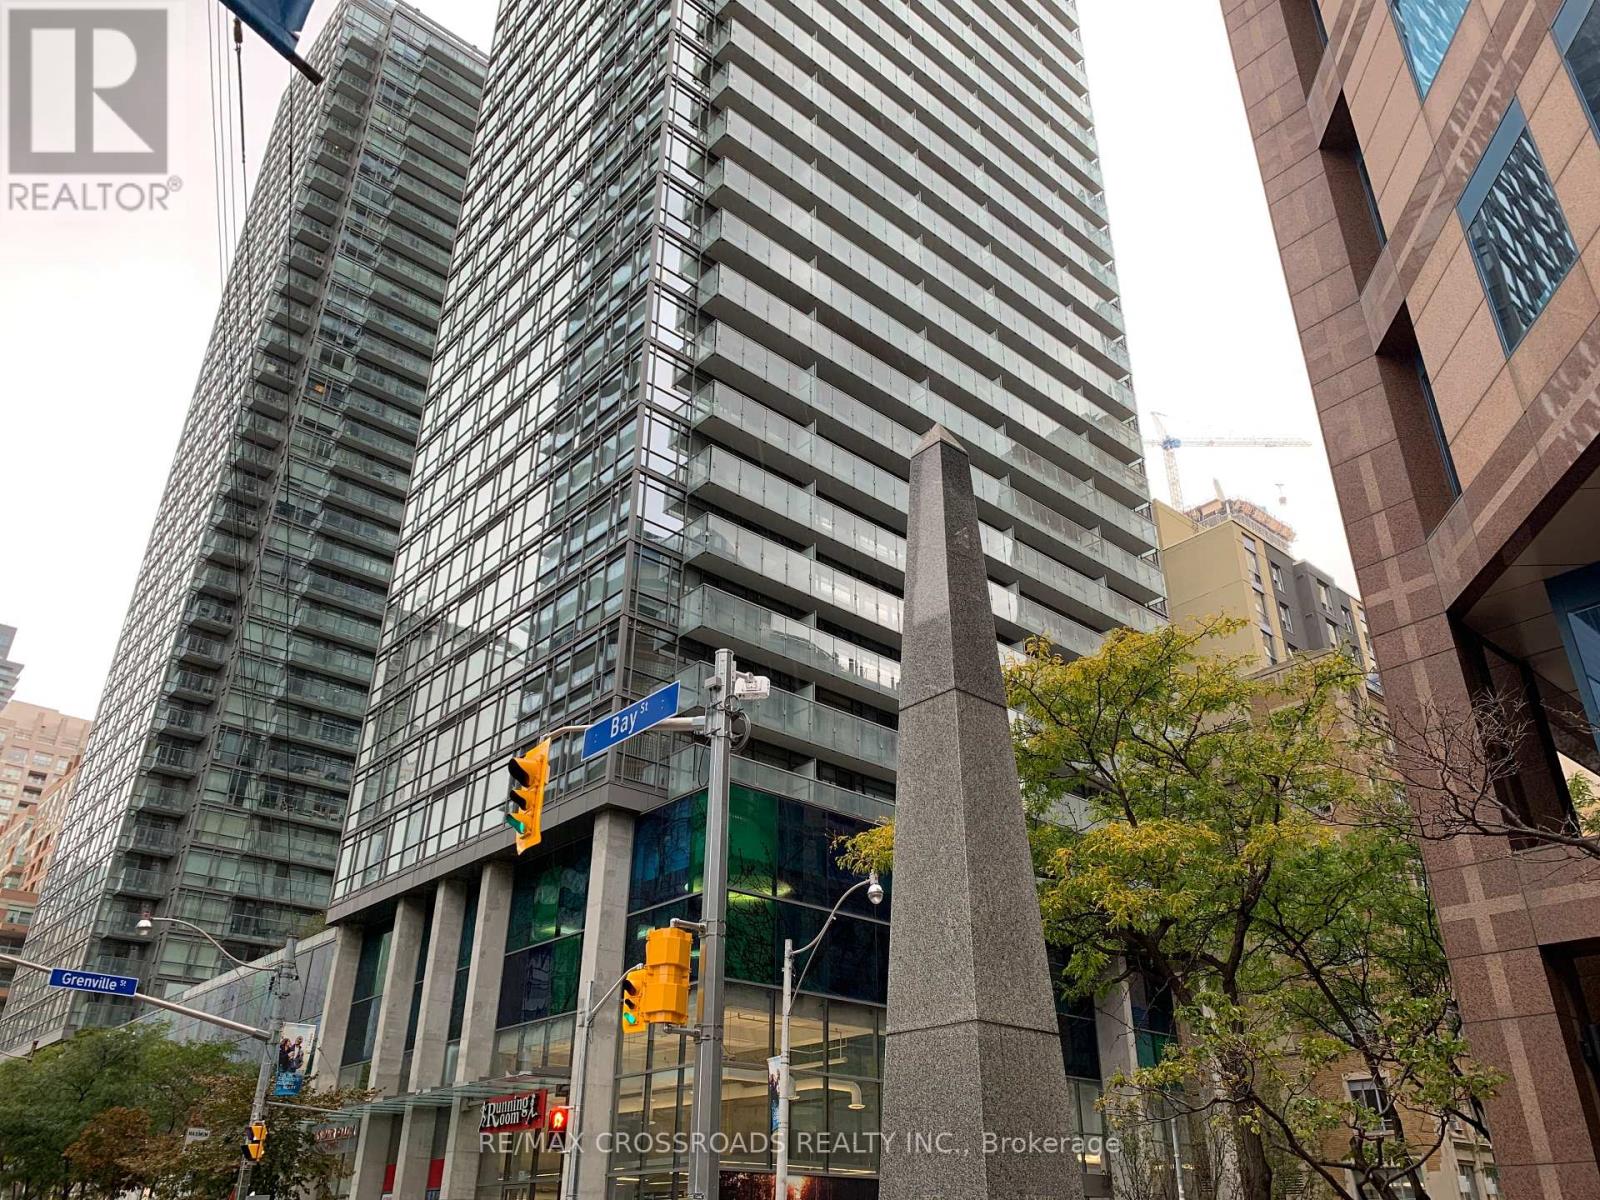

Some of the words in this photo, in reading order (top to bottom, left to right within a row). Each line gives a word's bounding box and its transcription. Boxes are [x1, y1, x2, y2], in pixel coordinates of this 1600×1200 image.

[610, 709, 638, 738] Bay
[640, 701, 649, 714] St
[62, 973, 117, 991] Grenville
[119, 979, 127, 987] St
[485, 1095, 530, 1128] Running
